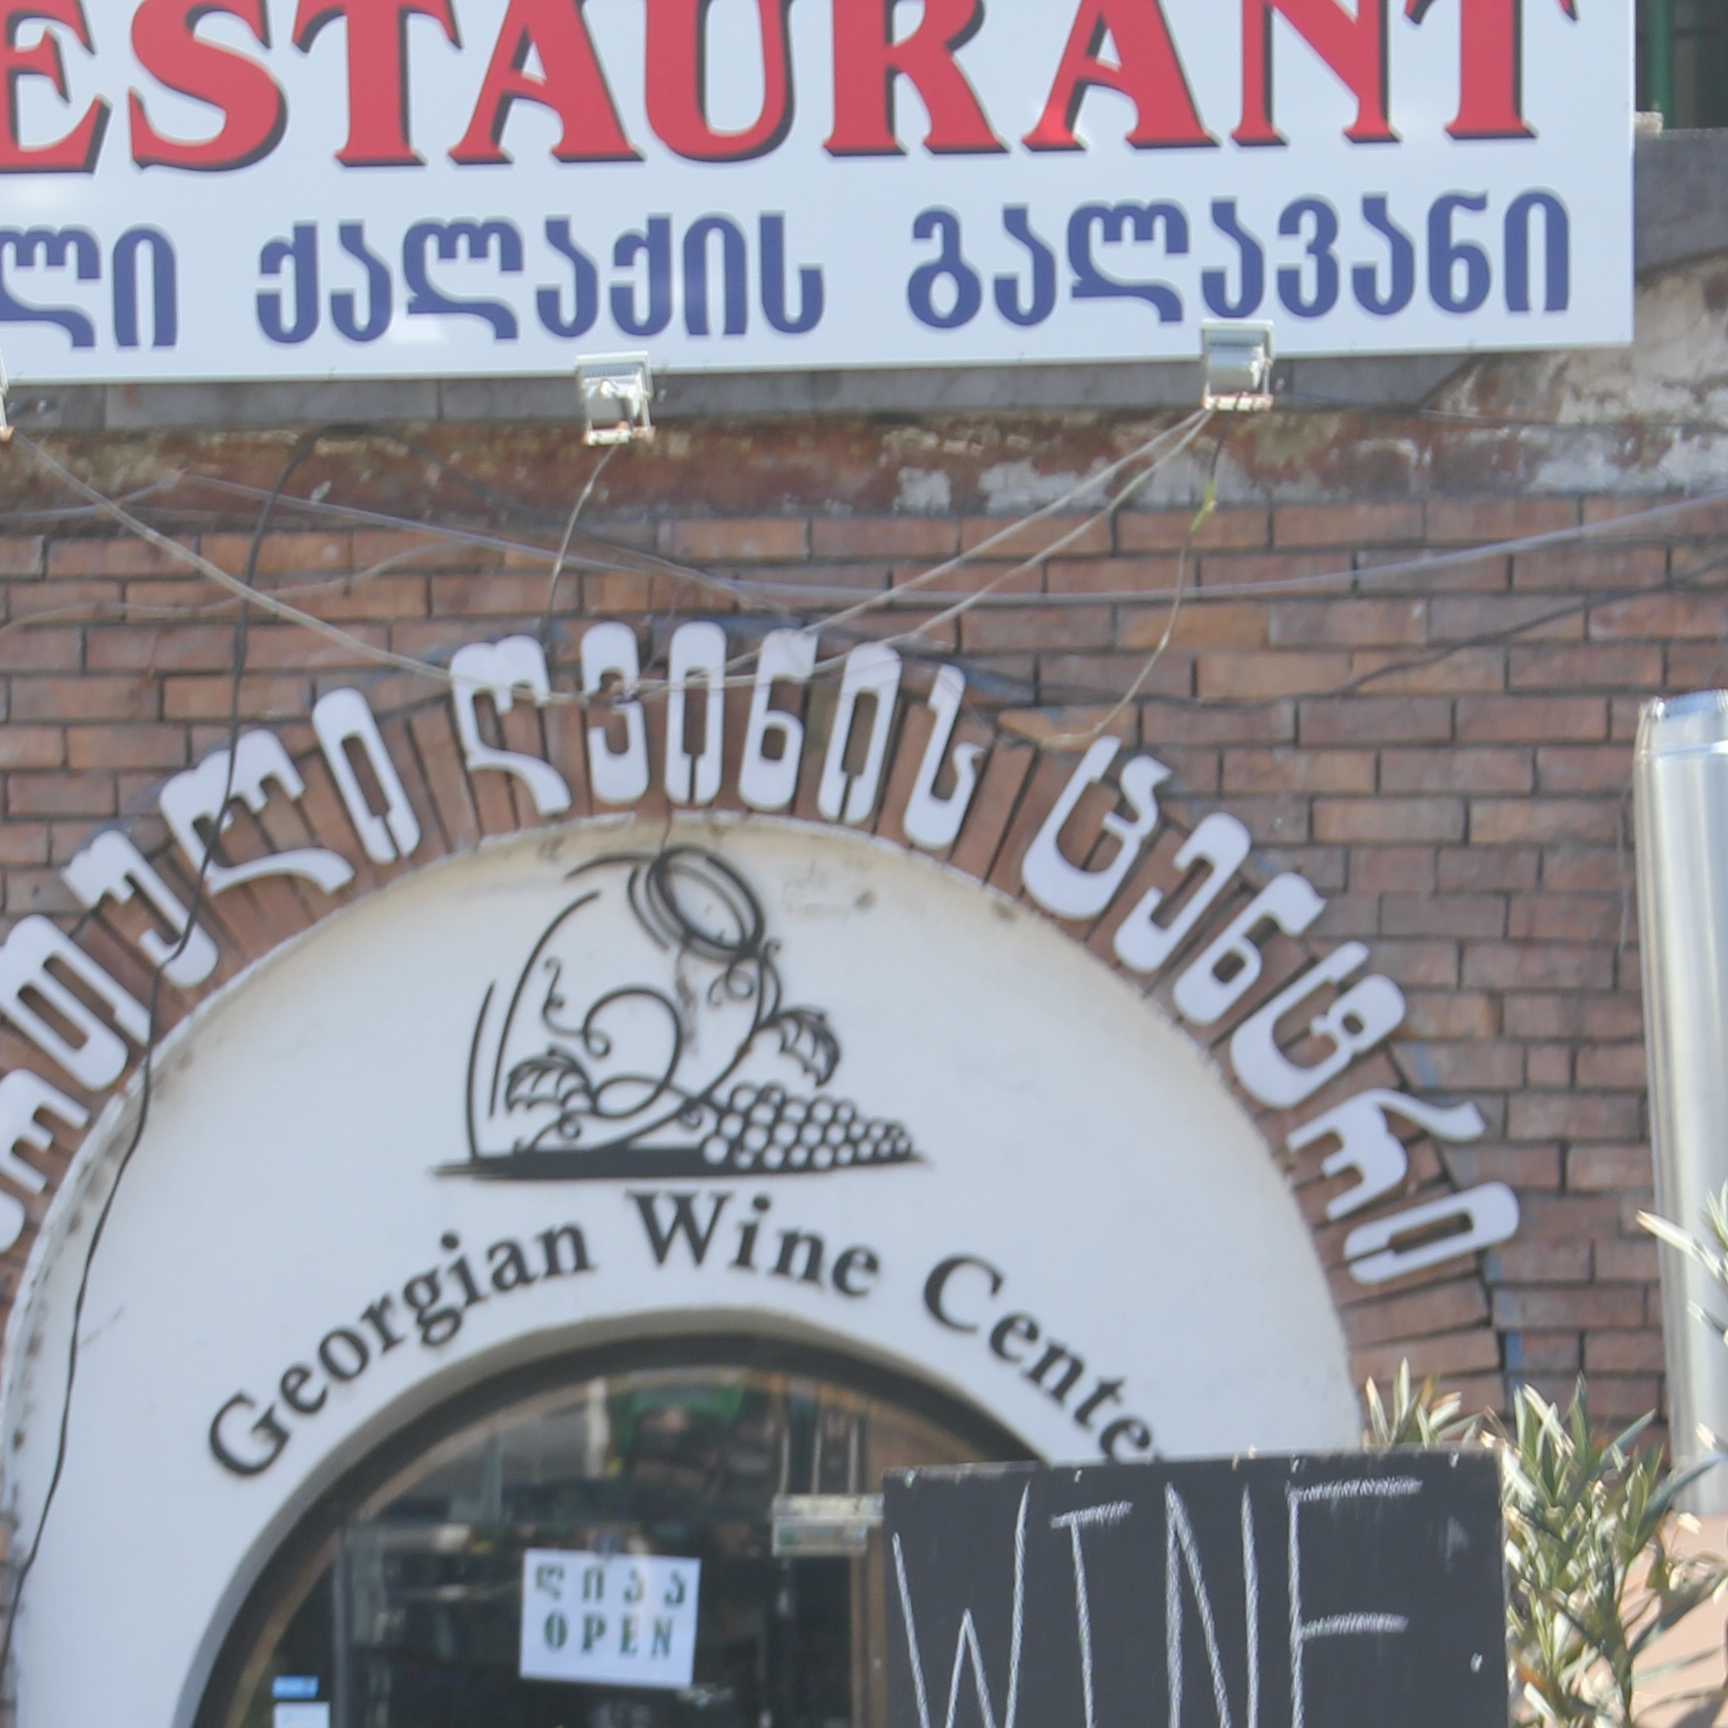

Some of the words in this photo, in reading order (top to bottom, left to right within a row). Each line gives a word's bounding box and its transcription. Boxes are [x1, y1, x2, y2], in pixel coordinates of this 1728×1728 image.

[254, 211, 826, 345] ქალაქის
[906, 187, 1571, 328] გალავანი
[450, 621, 984, 850] ღვინის
[1022, 736, 1520, 1285] ცენტრი
[208, 1215, 596, 1480] Georgian
[626, 1188, 881, 1298] Wine
[922, 1252, 1165, 1465] Cente
[543, 1611, 674, 1660] OPEN
